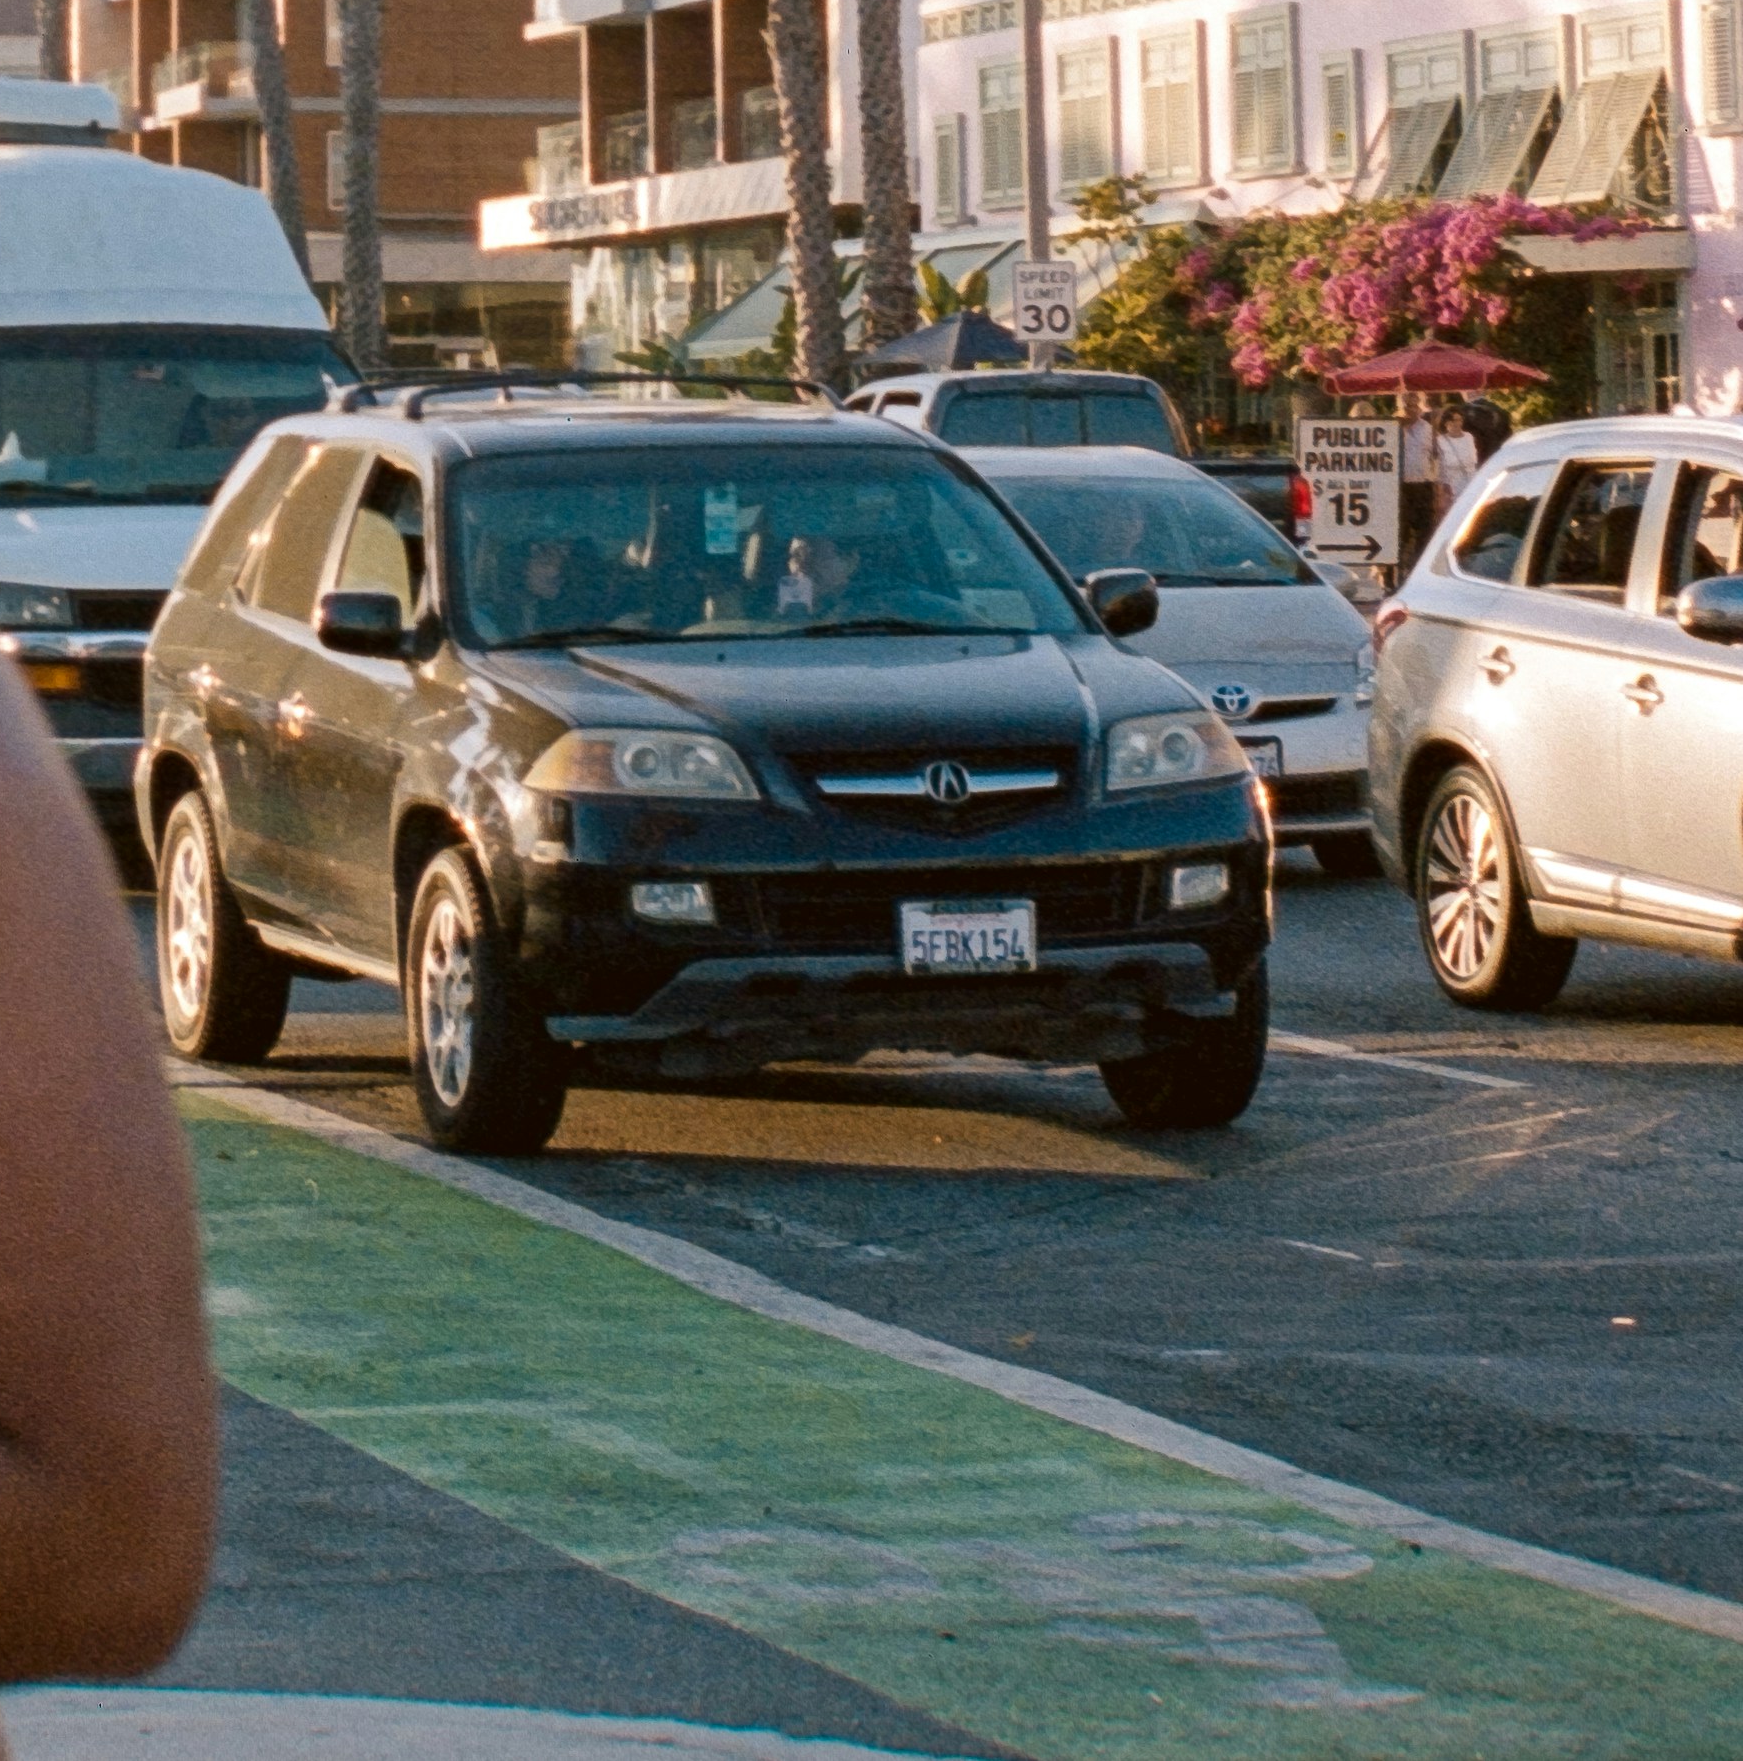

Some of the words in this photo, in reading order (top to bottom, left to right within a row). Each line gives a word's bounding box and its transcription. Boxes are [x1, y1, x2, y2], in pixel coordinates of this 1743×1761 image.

[1019, 270, 1071, 283] SPEED
[1023, 287, 1065, 300] LIMIT
[1022, 304, 1071, 334] 30
[1312, 426, 1387, 448] PUBLIC
[1304, 451, 1394, 473] PARKING
[1328, 492, 1370, 526] 15
